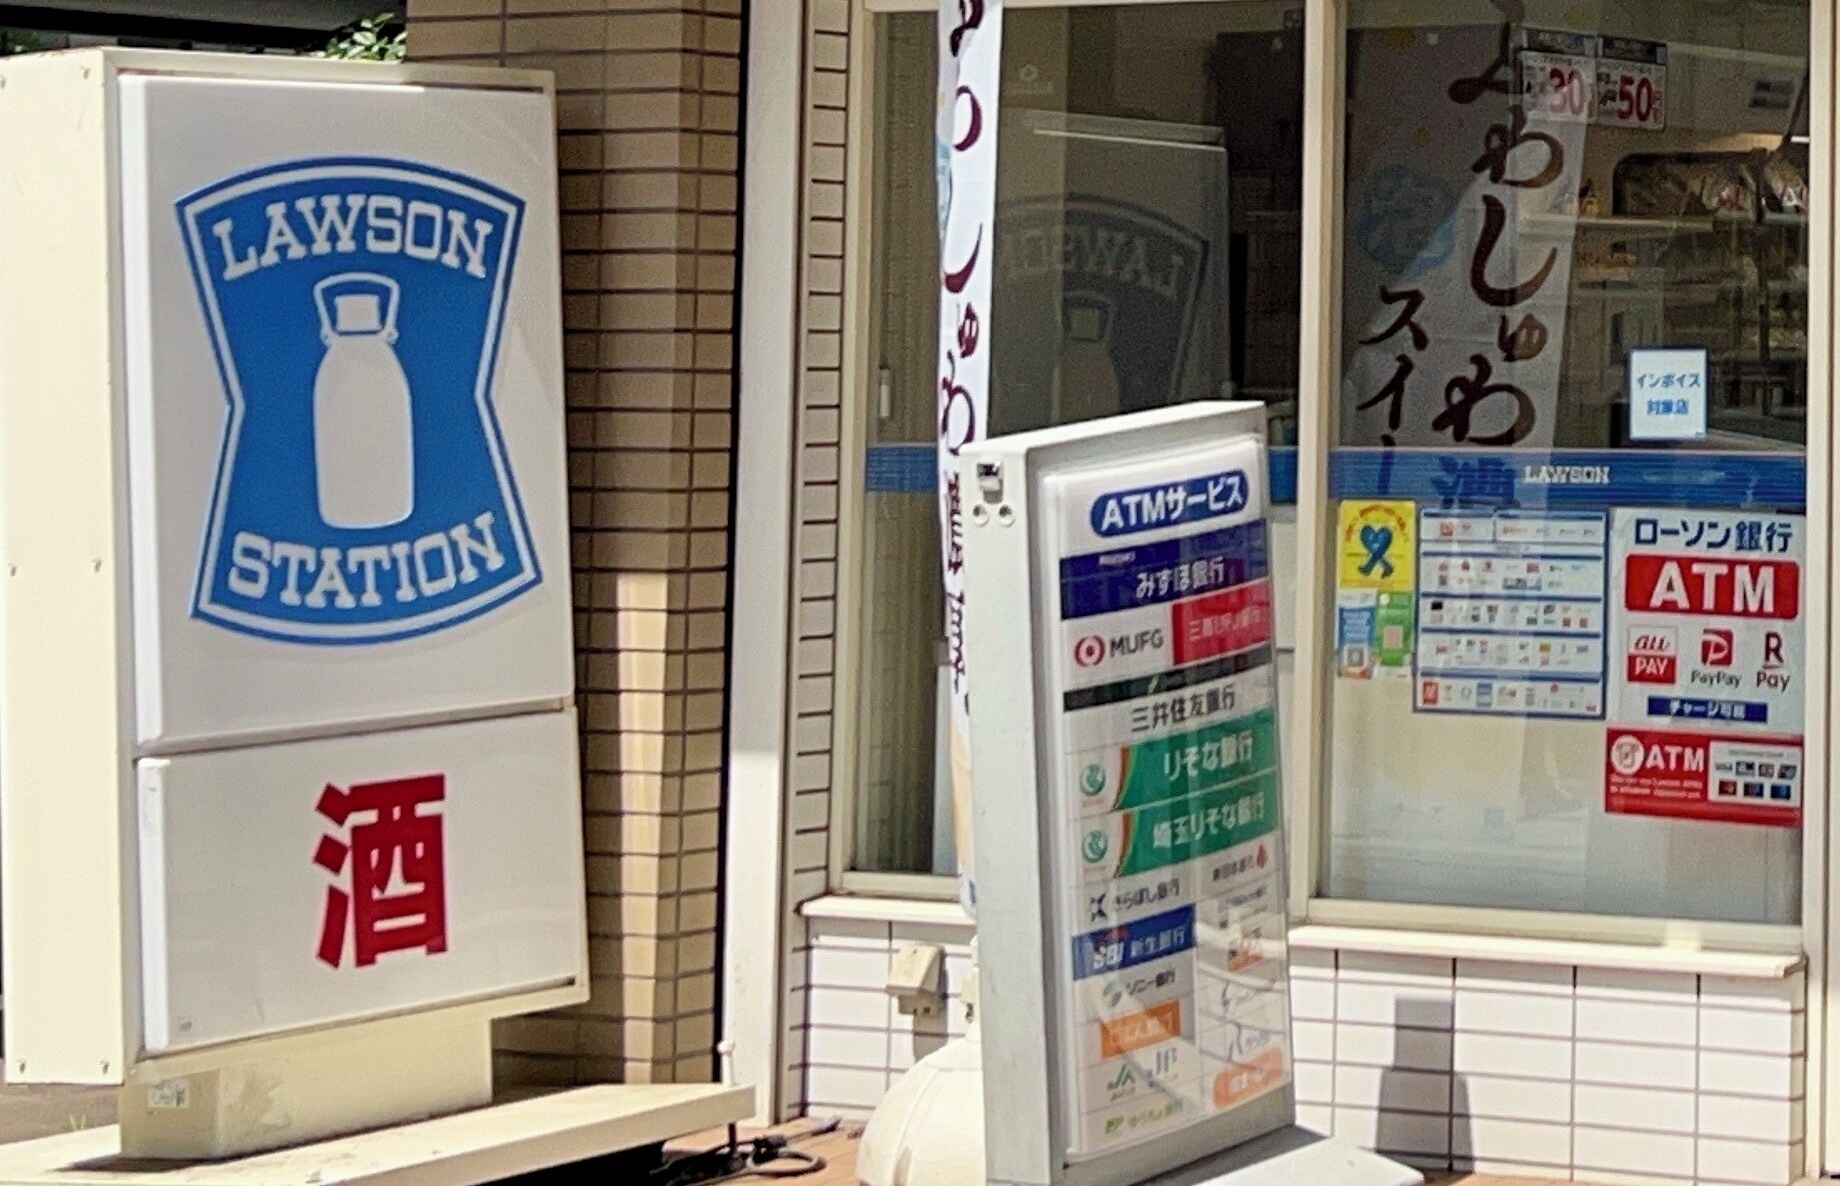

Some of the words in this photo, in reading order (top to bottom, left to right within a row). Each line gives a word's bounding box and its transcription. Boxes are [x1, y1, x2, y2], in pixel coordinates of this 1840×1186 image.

[1617, 74, 1653, 122] 50
[212, 192, 495, 281] LAWSON
[1525, 466, 1611, 485] LAWSON
[1101, 476, 1243, 532] ATMサービス
[1635, 518, 1793, 553] ローソン銀行
[228, 512, 506, 607] STATION
[1651, 561, 1775, 613] ATM
[1110, 629, 1164, 657] MUFG
[1634, 633, 1670, 650] au
[1635, 657, 1668, 676] PAY
[1691, 670, 1742, 688] PayPay
[1756, 671, 1790, 692] Pay
[1646, 744, 1705, 772] ATM
[313, 772, 449, 969] 酒
